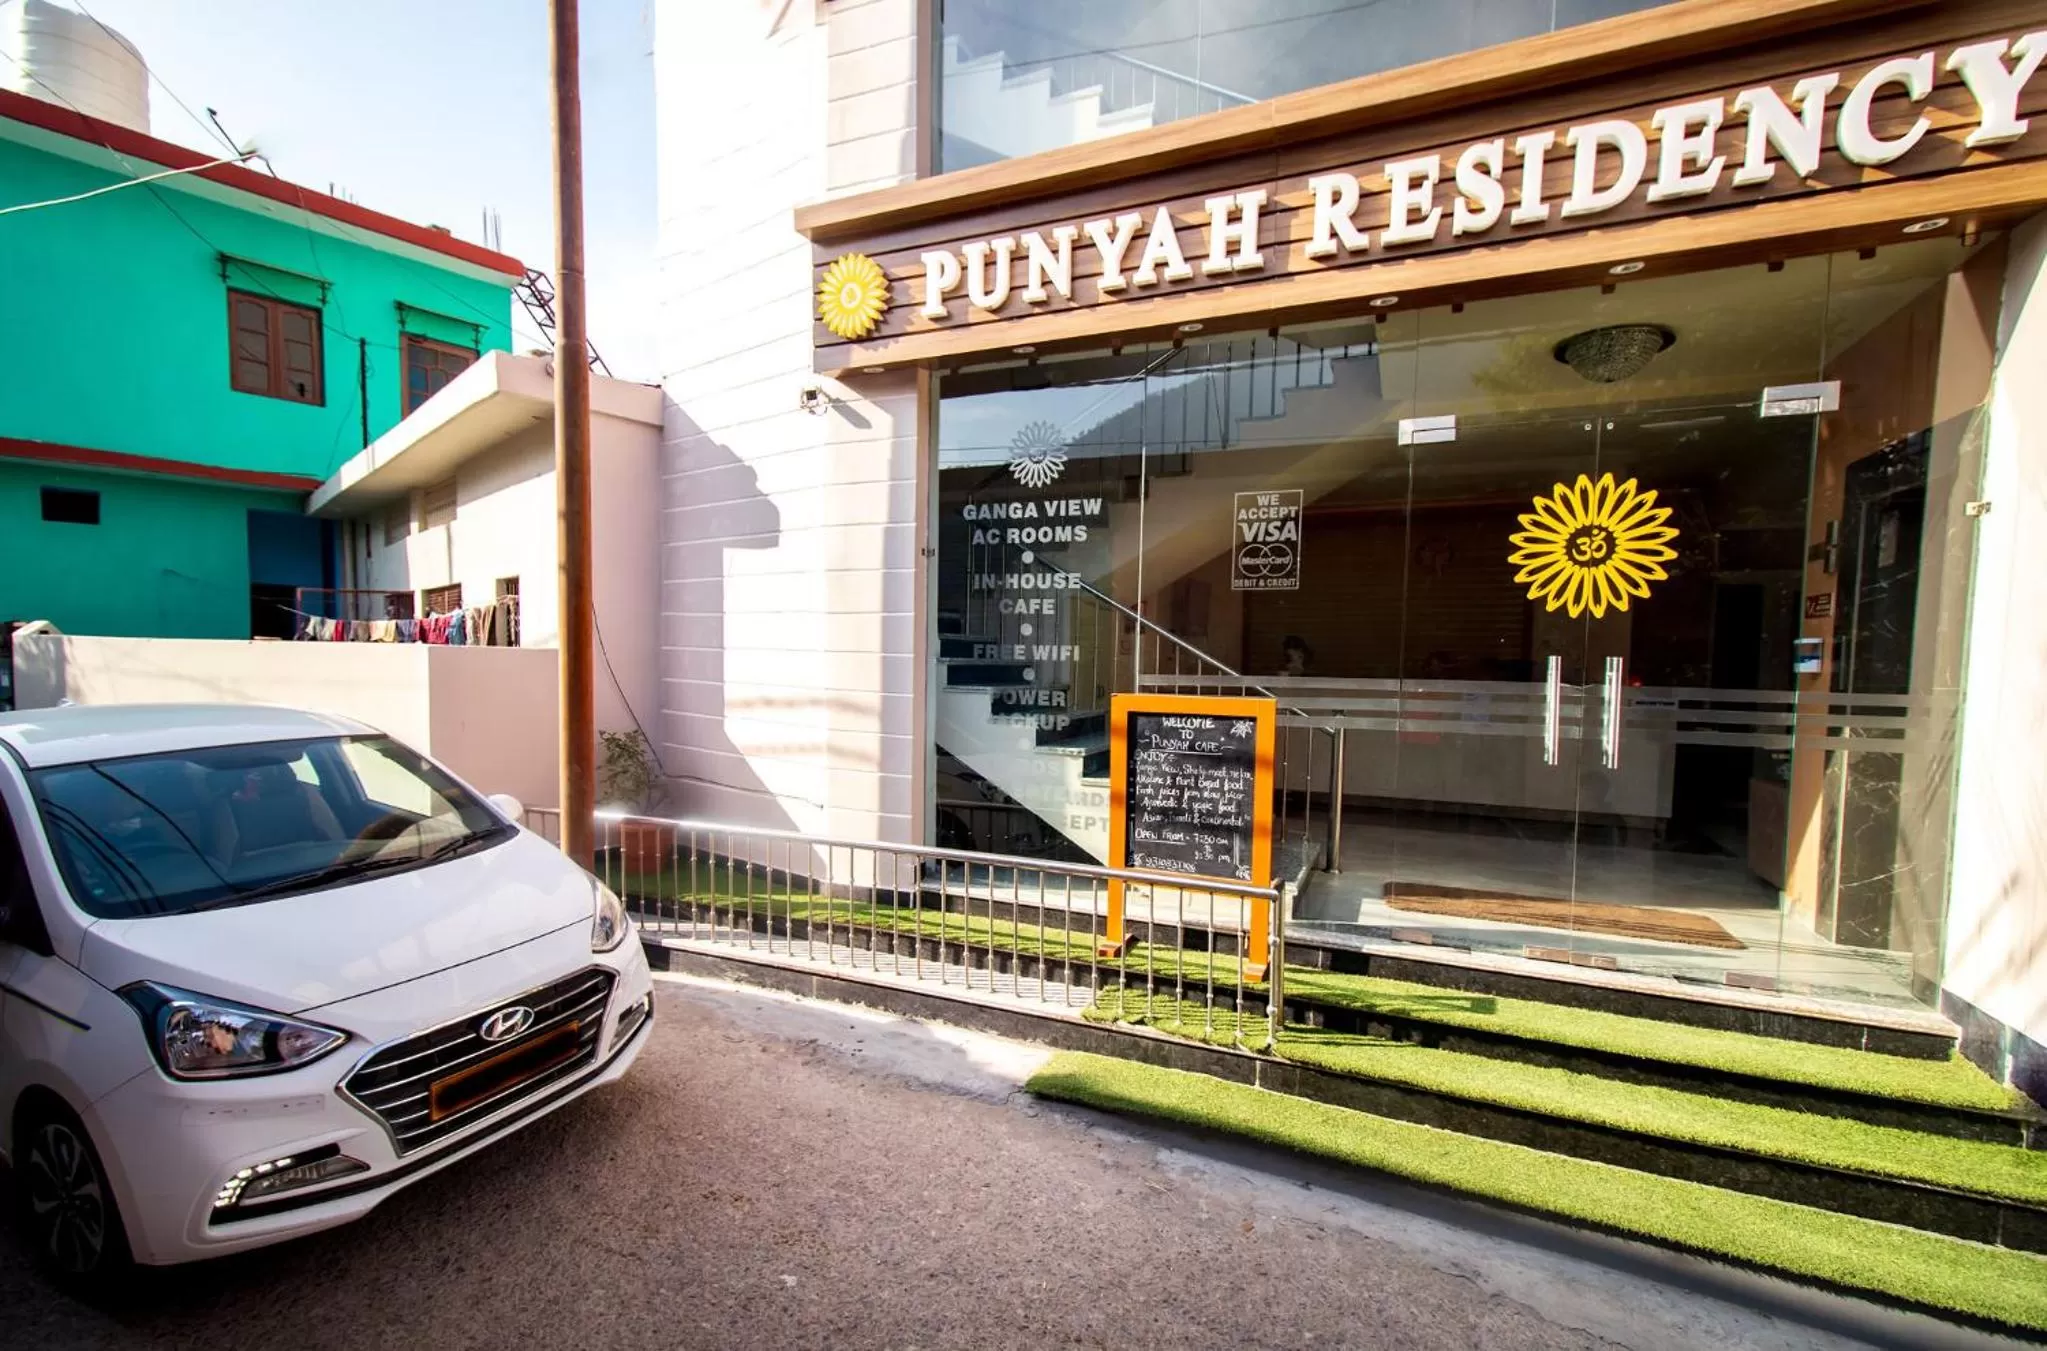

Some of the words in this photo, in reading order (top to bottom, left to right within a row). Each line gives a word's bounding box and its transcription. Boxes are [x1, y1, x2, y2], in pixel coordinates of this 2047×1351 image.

[920, 189, 1268, 319] PUNYAH
[1305, 31, 2047, 259] RESIDENCY
[1257, 494, 1280, 506] WE
[963, 502, 1038, 521] GANGA
[1044, 498, 1102, 517] VIEW
[1238, 506, 1299, 520] ACCEPT
[972, 529, 1000, 545] AC
[1007, 525, 1088, 544] ROOMS
[1237, 521, 1297, 542] VISA
[973, 573, 1081, 589] IN-HOUSE
[999, 599, 1056, 615] CAFE
[973, 644, 1026, 660] FREE
[1032, 645, 1080, 662] WIFI
[994, 688, 1067, 707] OWER
[1162, 717, 1215, 729] WELCOME
[1179, 729, 1194, 739] TO
[1195, 742, 1218, 752] CAFE
[1135, 828, 1158, 840] OPEN
